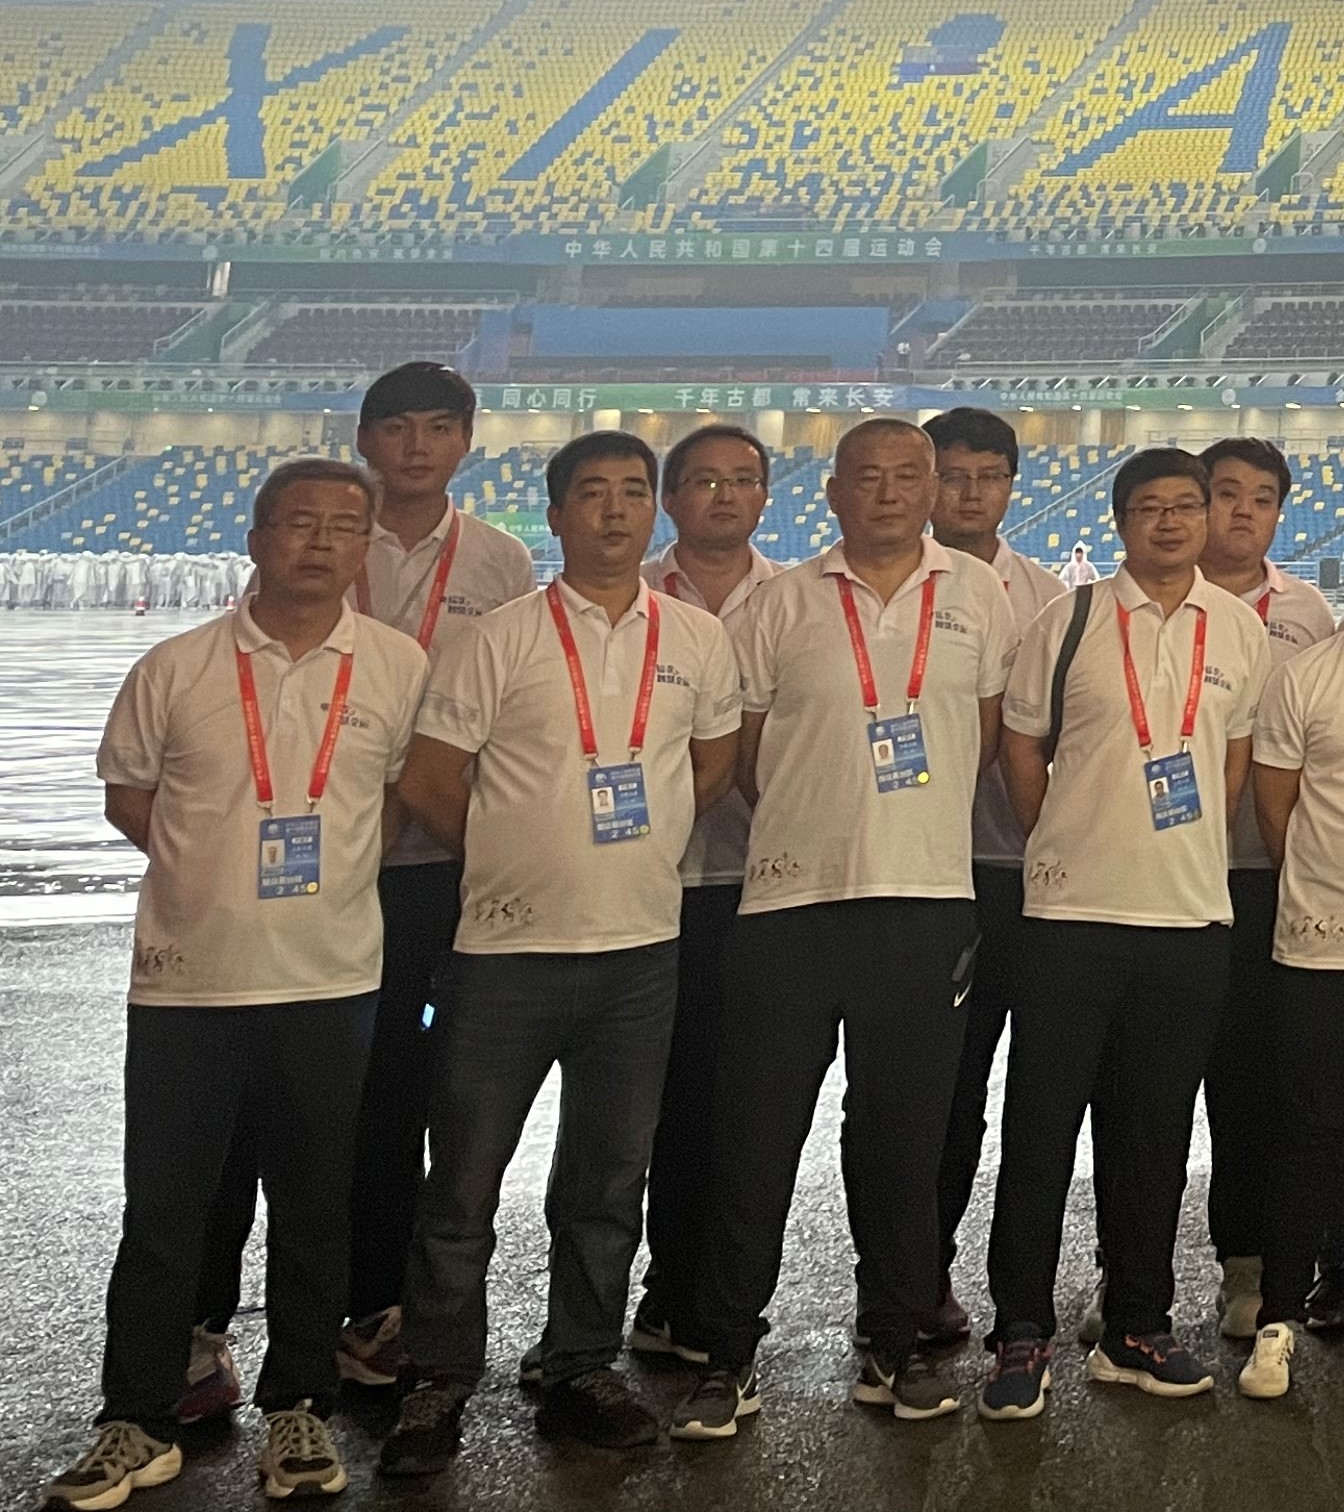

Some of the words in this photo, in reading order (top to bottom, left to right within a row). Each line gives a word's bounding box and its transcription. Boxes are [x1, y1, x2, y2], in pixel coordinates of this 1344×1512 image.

[564, 236, 942, 259] 中华人民共和国第十四届运动会
[502, 388, 597, 409] 同心同行
[674, 388, 772, 409] 千年古都
[792, 387, 893, 408] 常来长安
